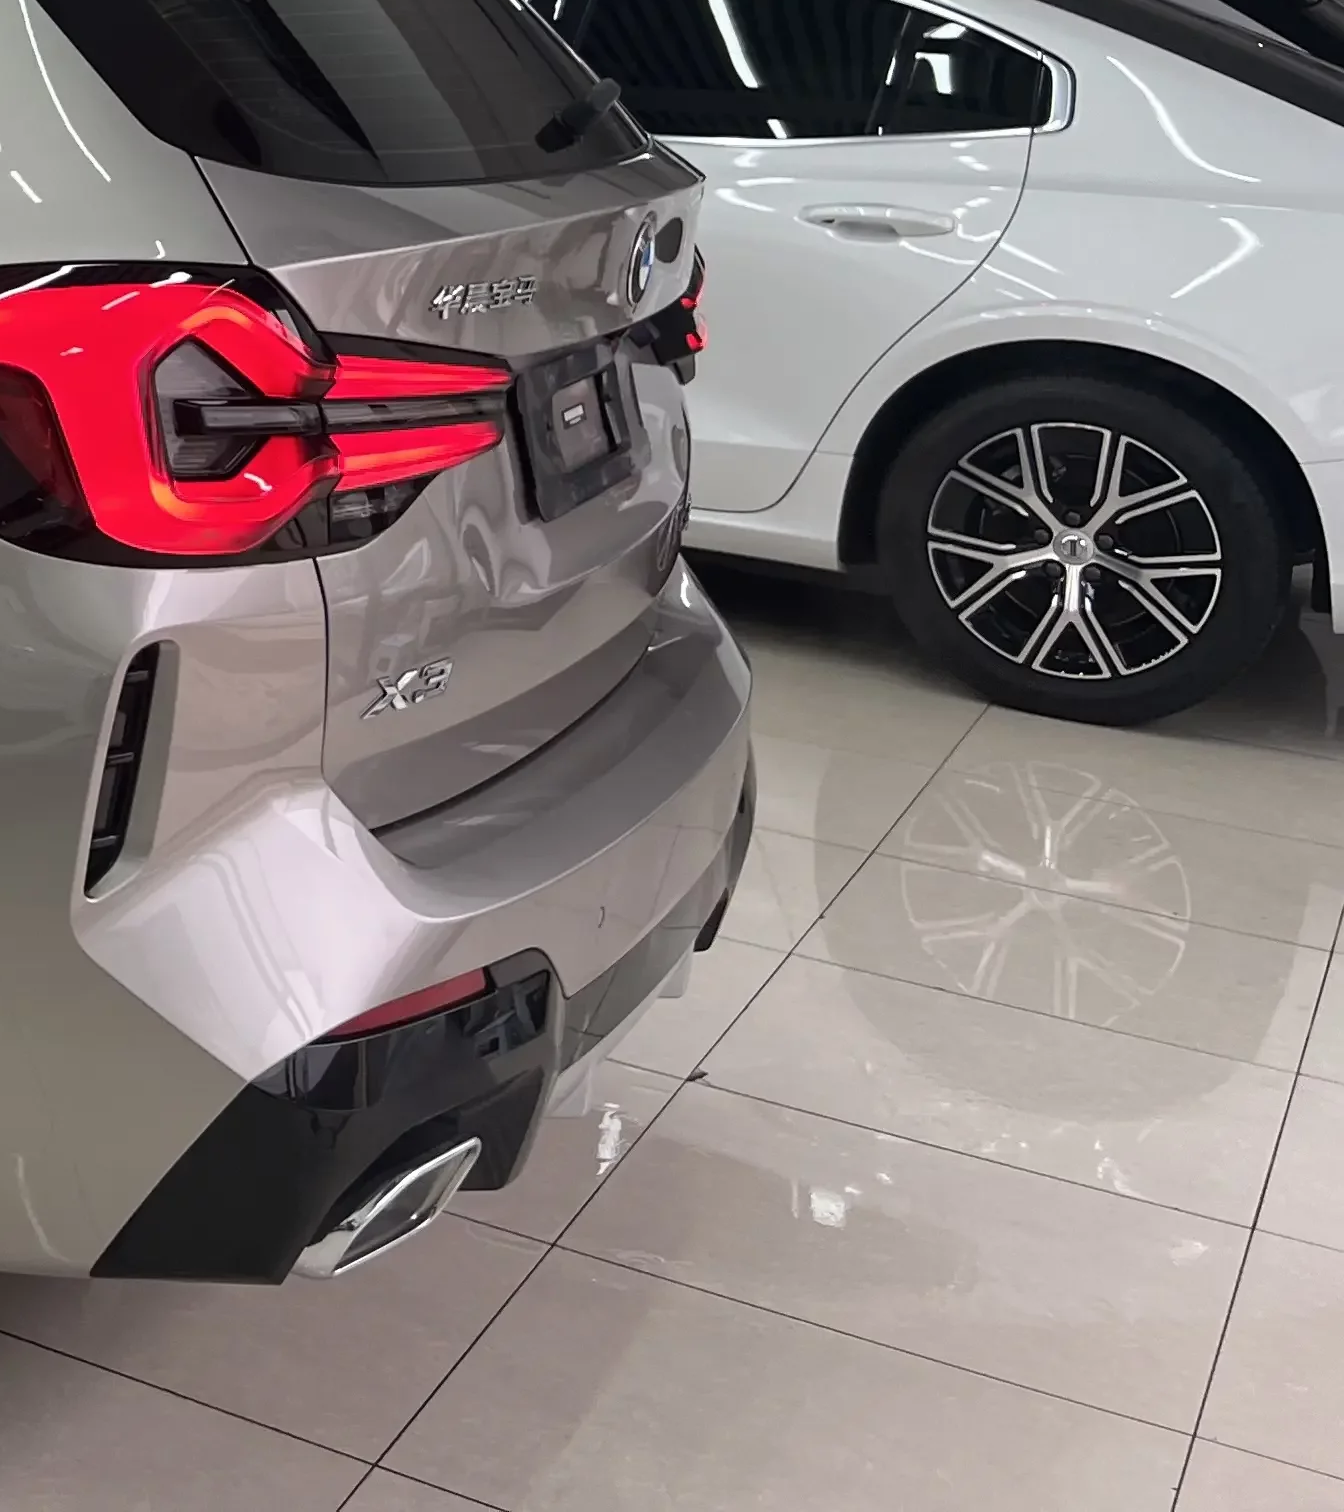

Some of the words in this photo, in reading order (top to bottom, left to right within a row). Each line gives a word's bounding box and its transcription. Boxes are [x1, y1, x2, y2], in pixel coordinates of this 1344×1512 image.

[429, 275, 537, 320] 华晨宝马
[359, 656, 454, 720] X3
